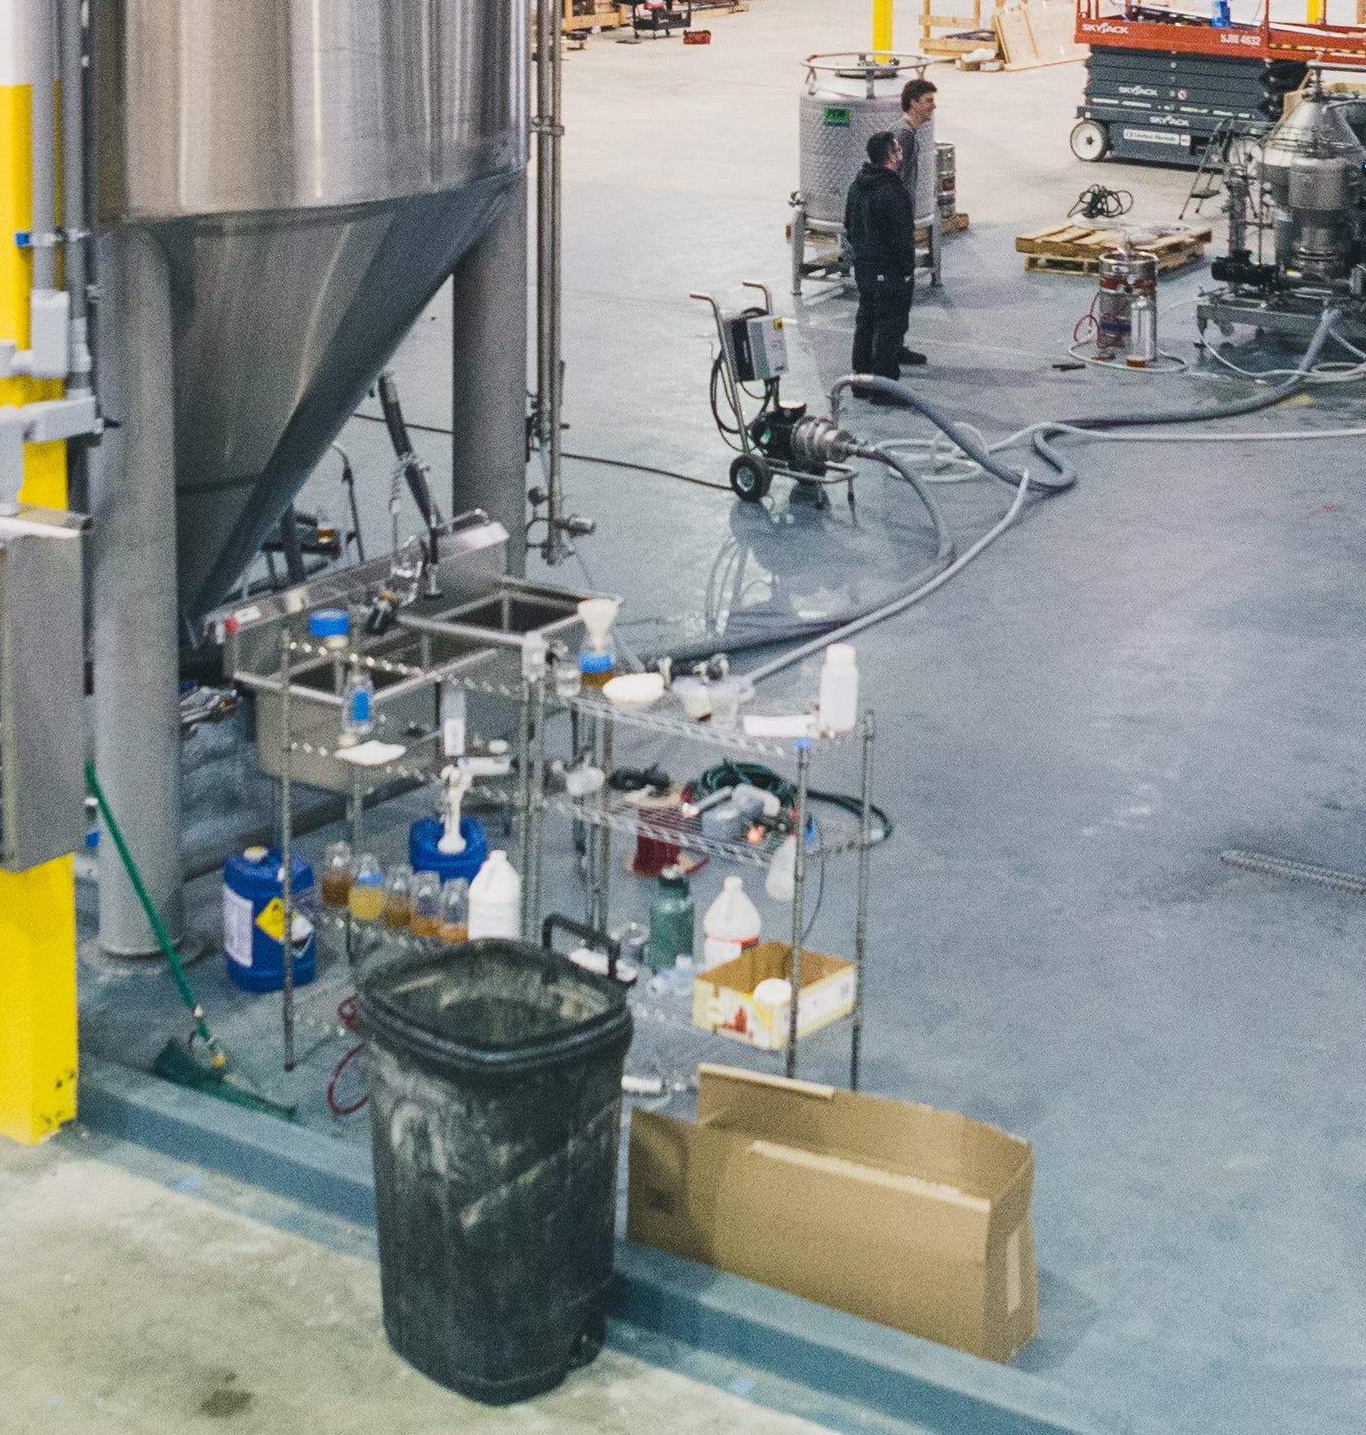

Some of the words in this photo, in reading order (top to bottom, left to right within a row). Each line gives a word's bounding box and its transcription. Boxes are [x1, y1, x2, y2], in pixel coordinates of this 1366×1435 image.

[1081, 22, 1129, 34] SKYJACK
[1118, 86, 1158, 96] SKYJACK
[1149, 115, 1190, 127] SKYJACK
